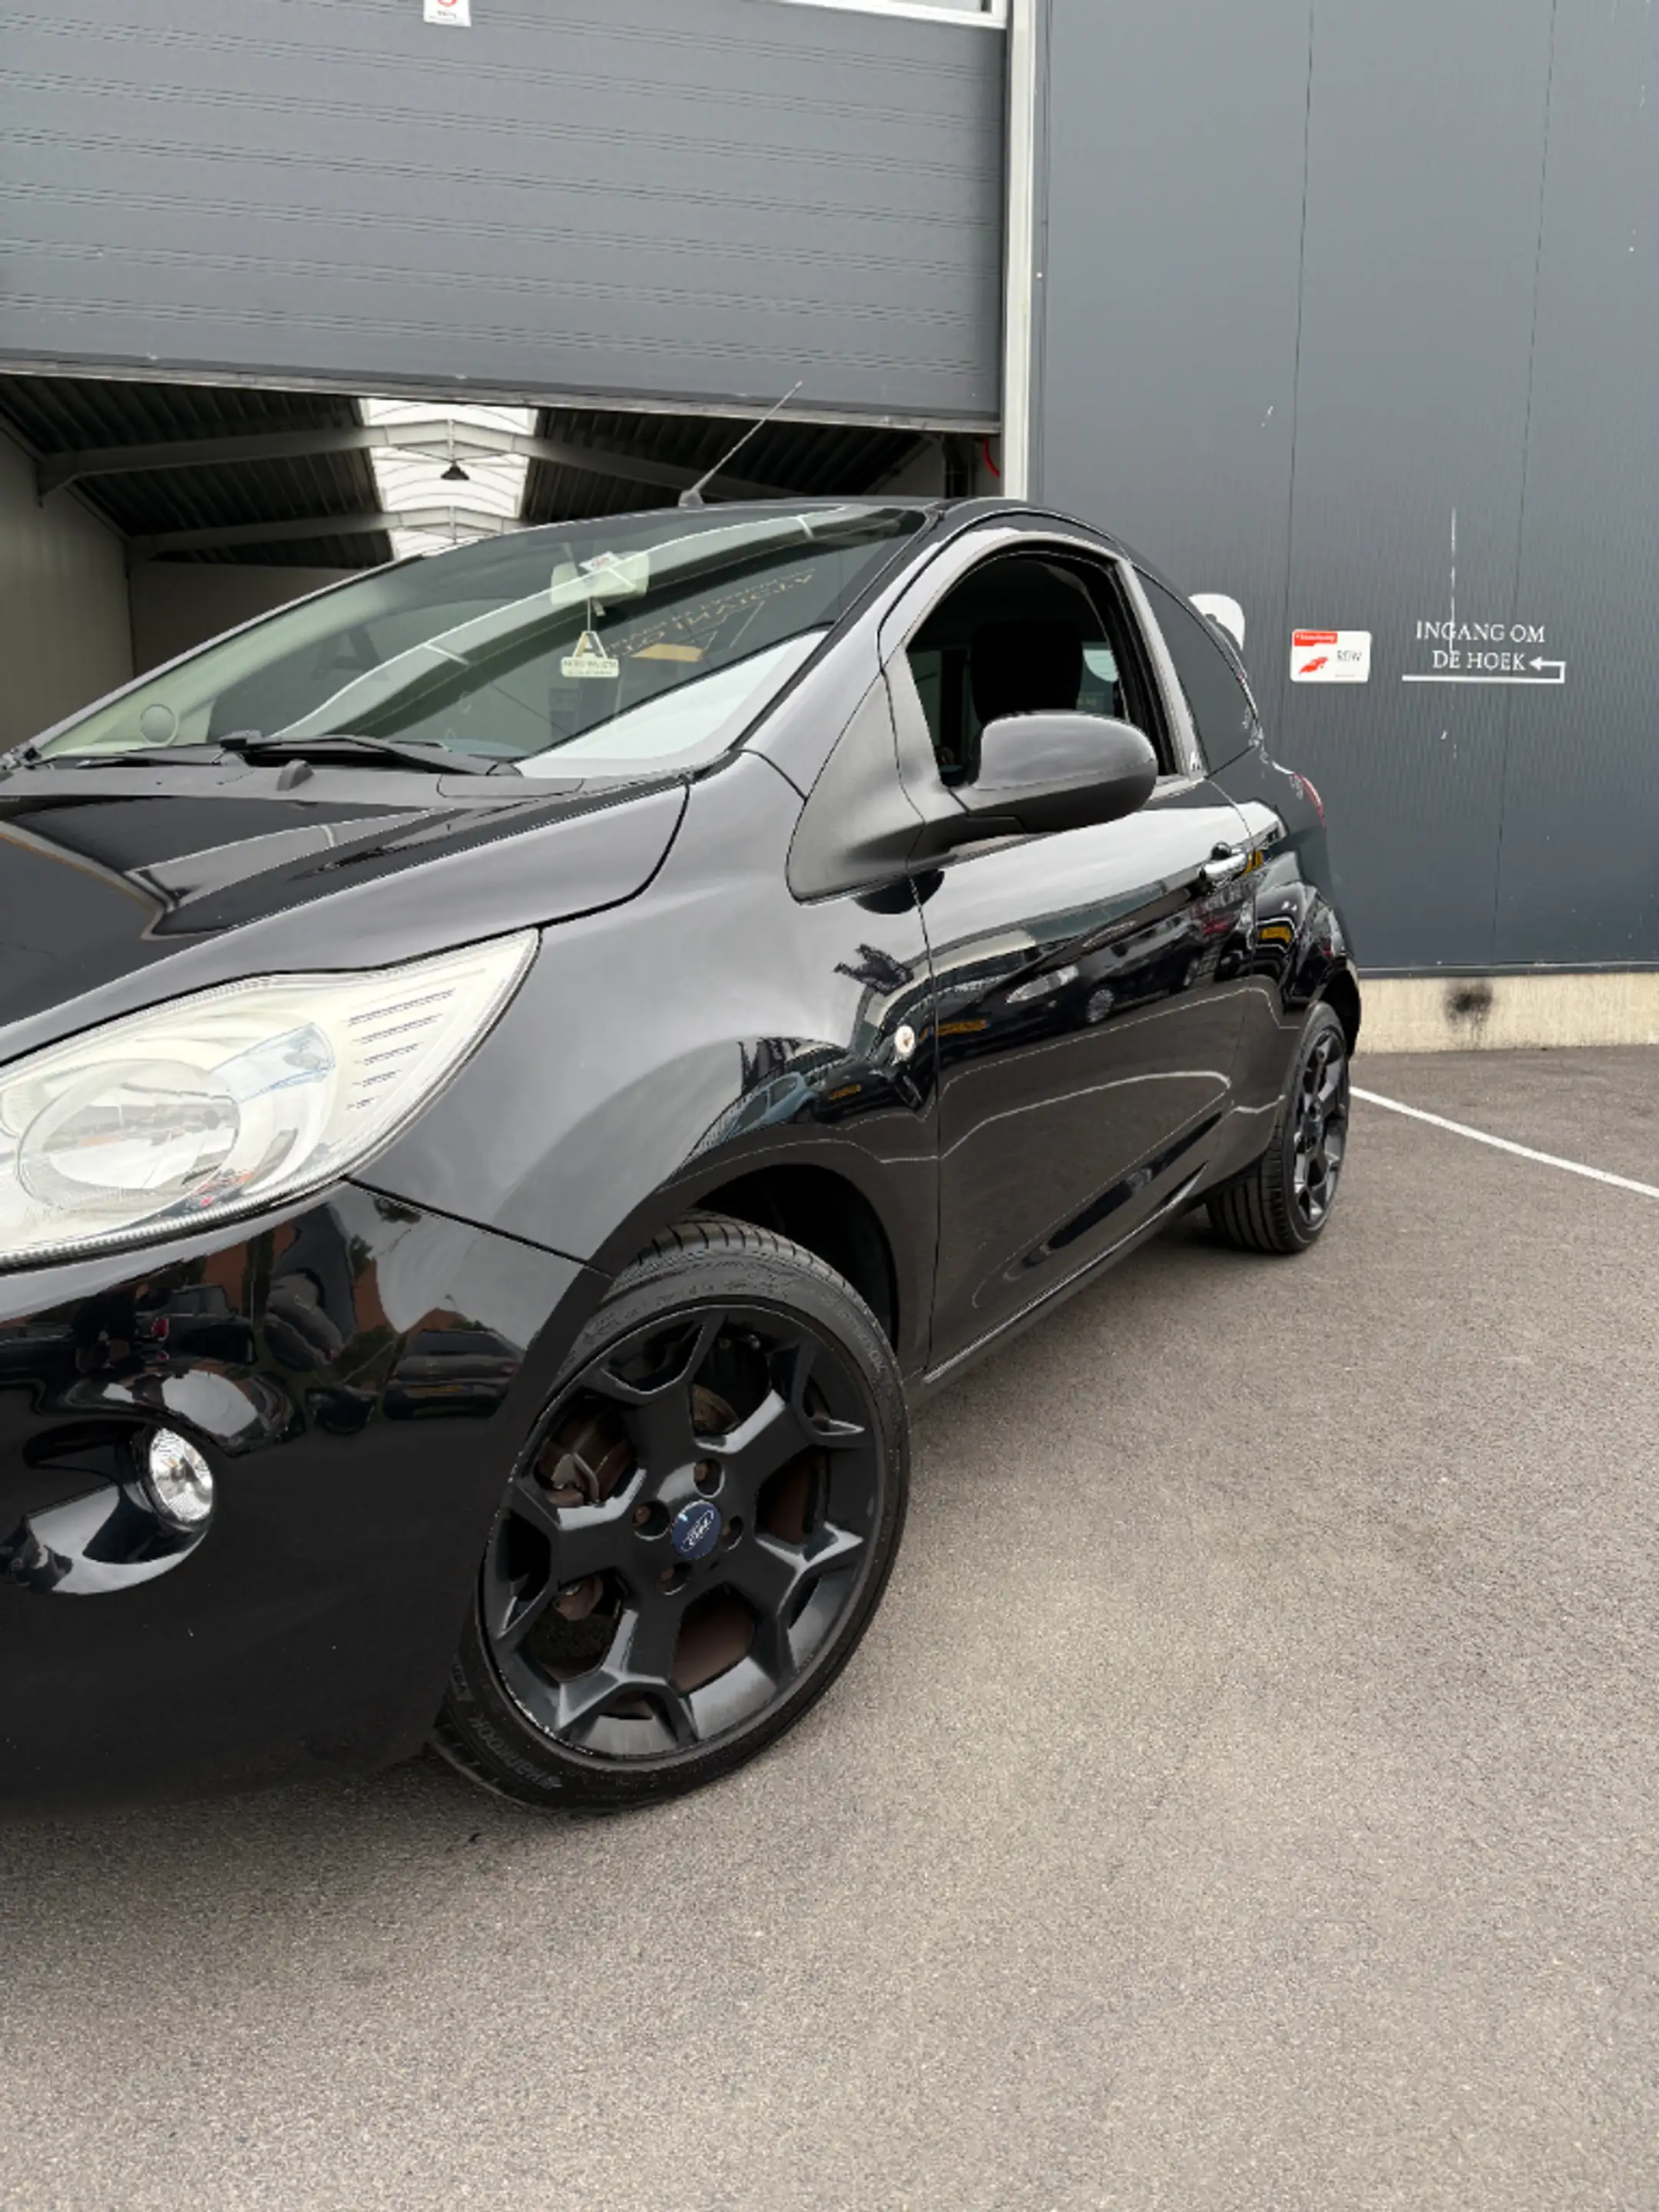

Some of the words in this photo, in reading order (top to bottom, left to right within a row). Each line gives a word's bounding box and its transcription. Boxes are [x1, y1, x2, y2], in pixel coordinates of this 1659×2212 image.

[1416, 621, 1505, 641] INGANG
[1509, 624, 1545, 643] OM
[1432, 650, 1460, 669] DE
[1467, 651, 1526, 671] HOEK
